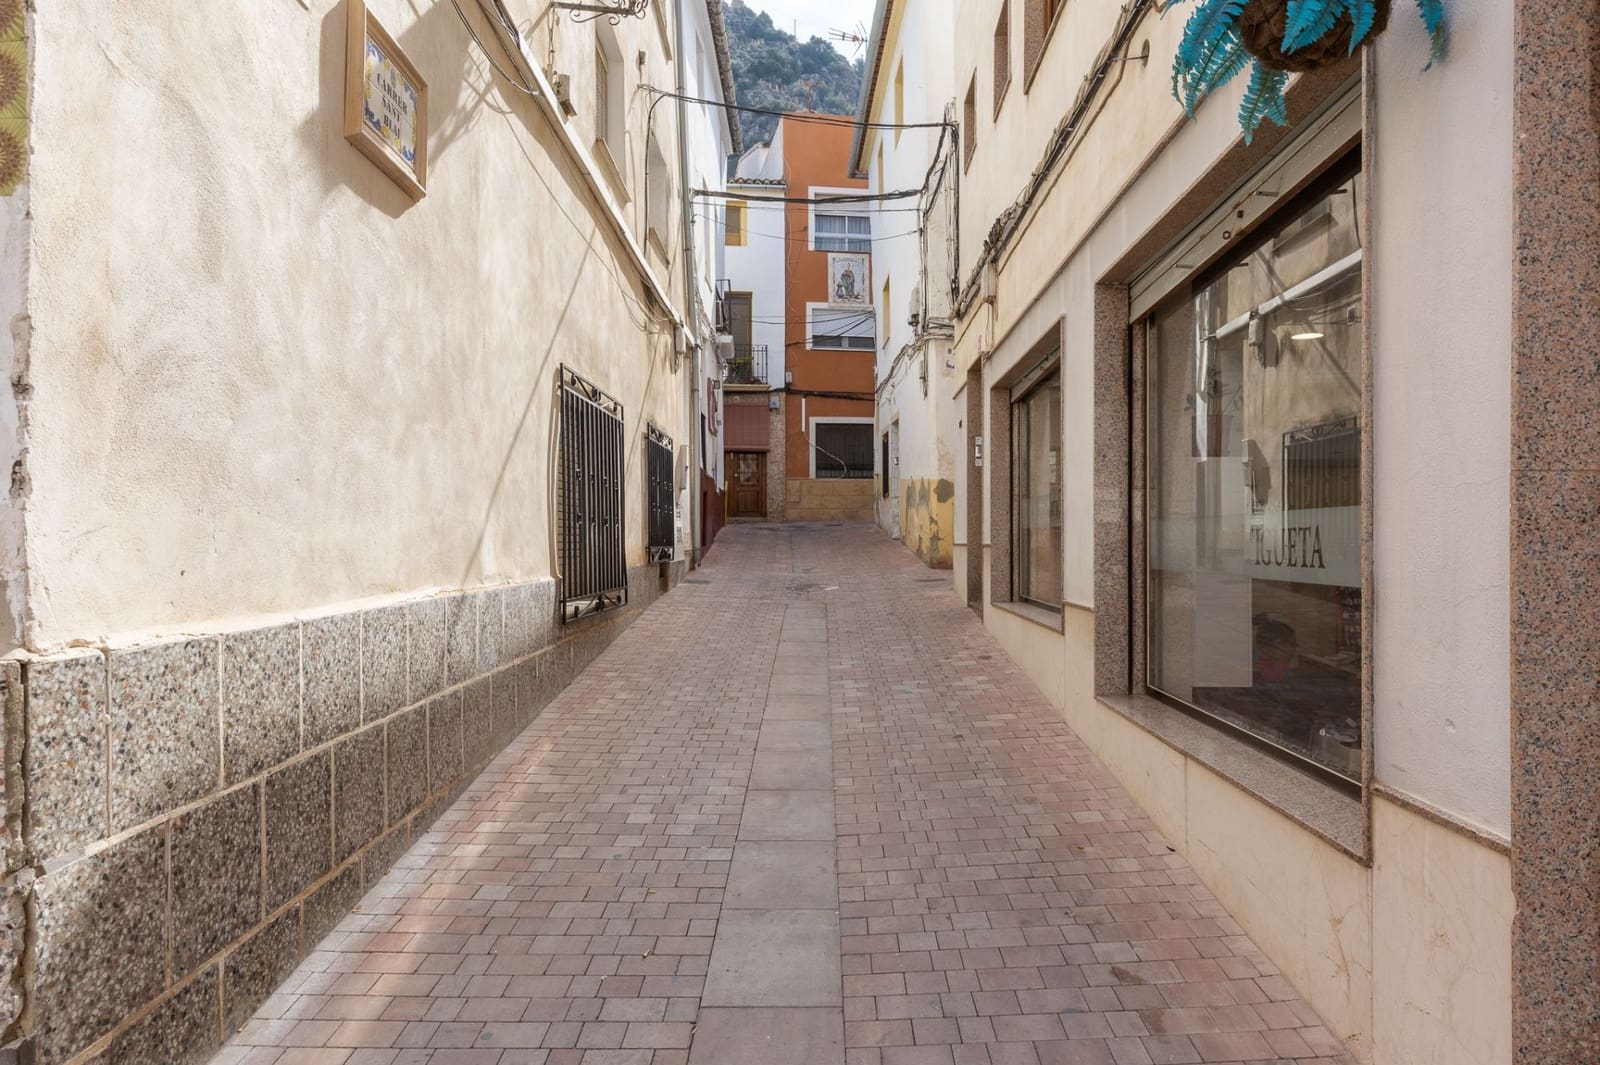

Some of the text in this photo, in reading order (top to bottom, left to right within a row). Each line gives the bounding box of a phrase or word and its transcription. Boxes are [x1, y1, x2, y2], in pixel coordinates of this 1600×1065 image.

[376, 72, 408, 115] CARRER
[382, 96, 401, 122] SANT
[383, 114, 400, 139] BLAI
